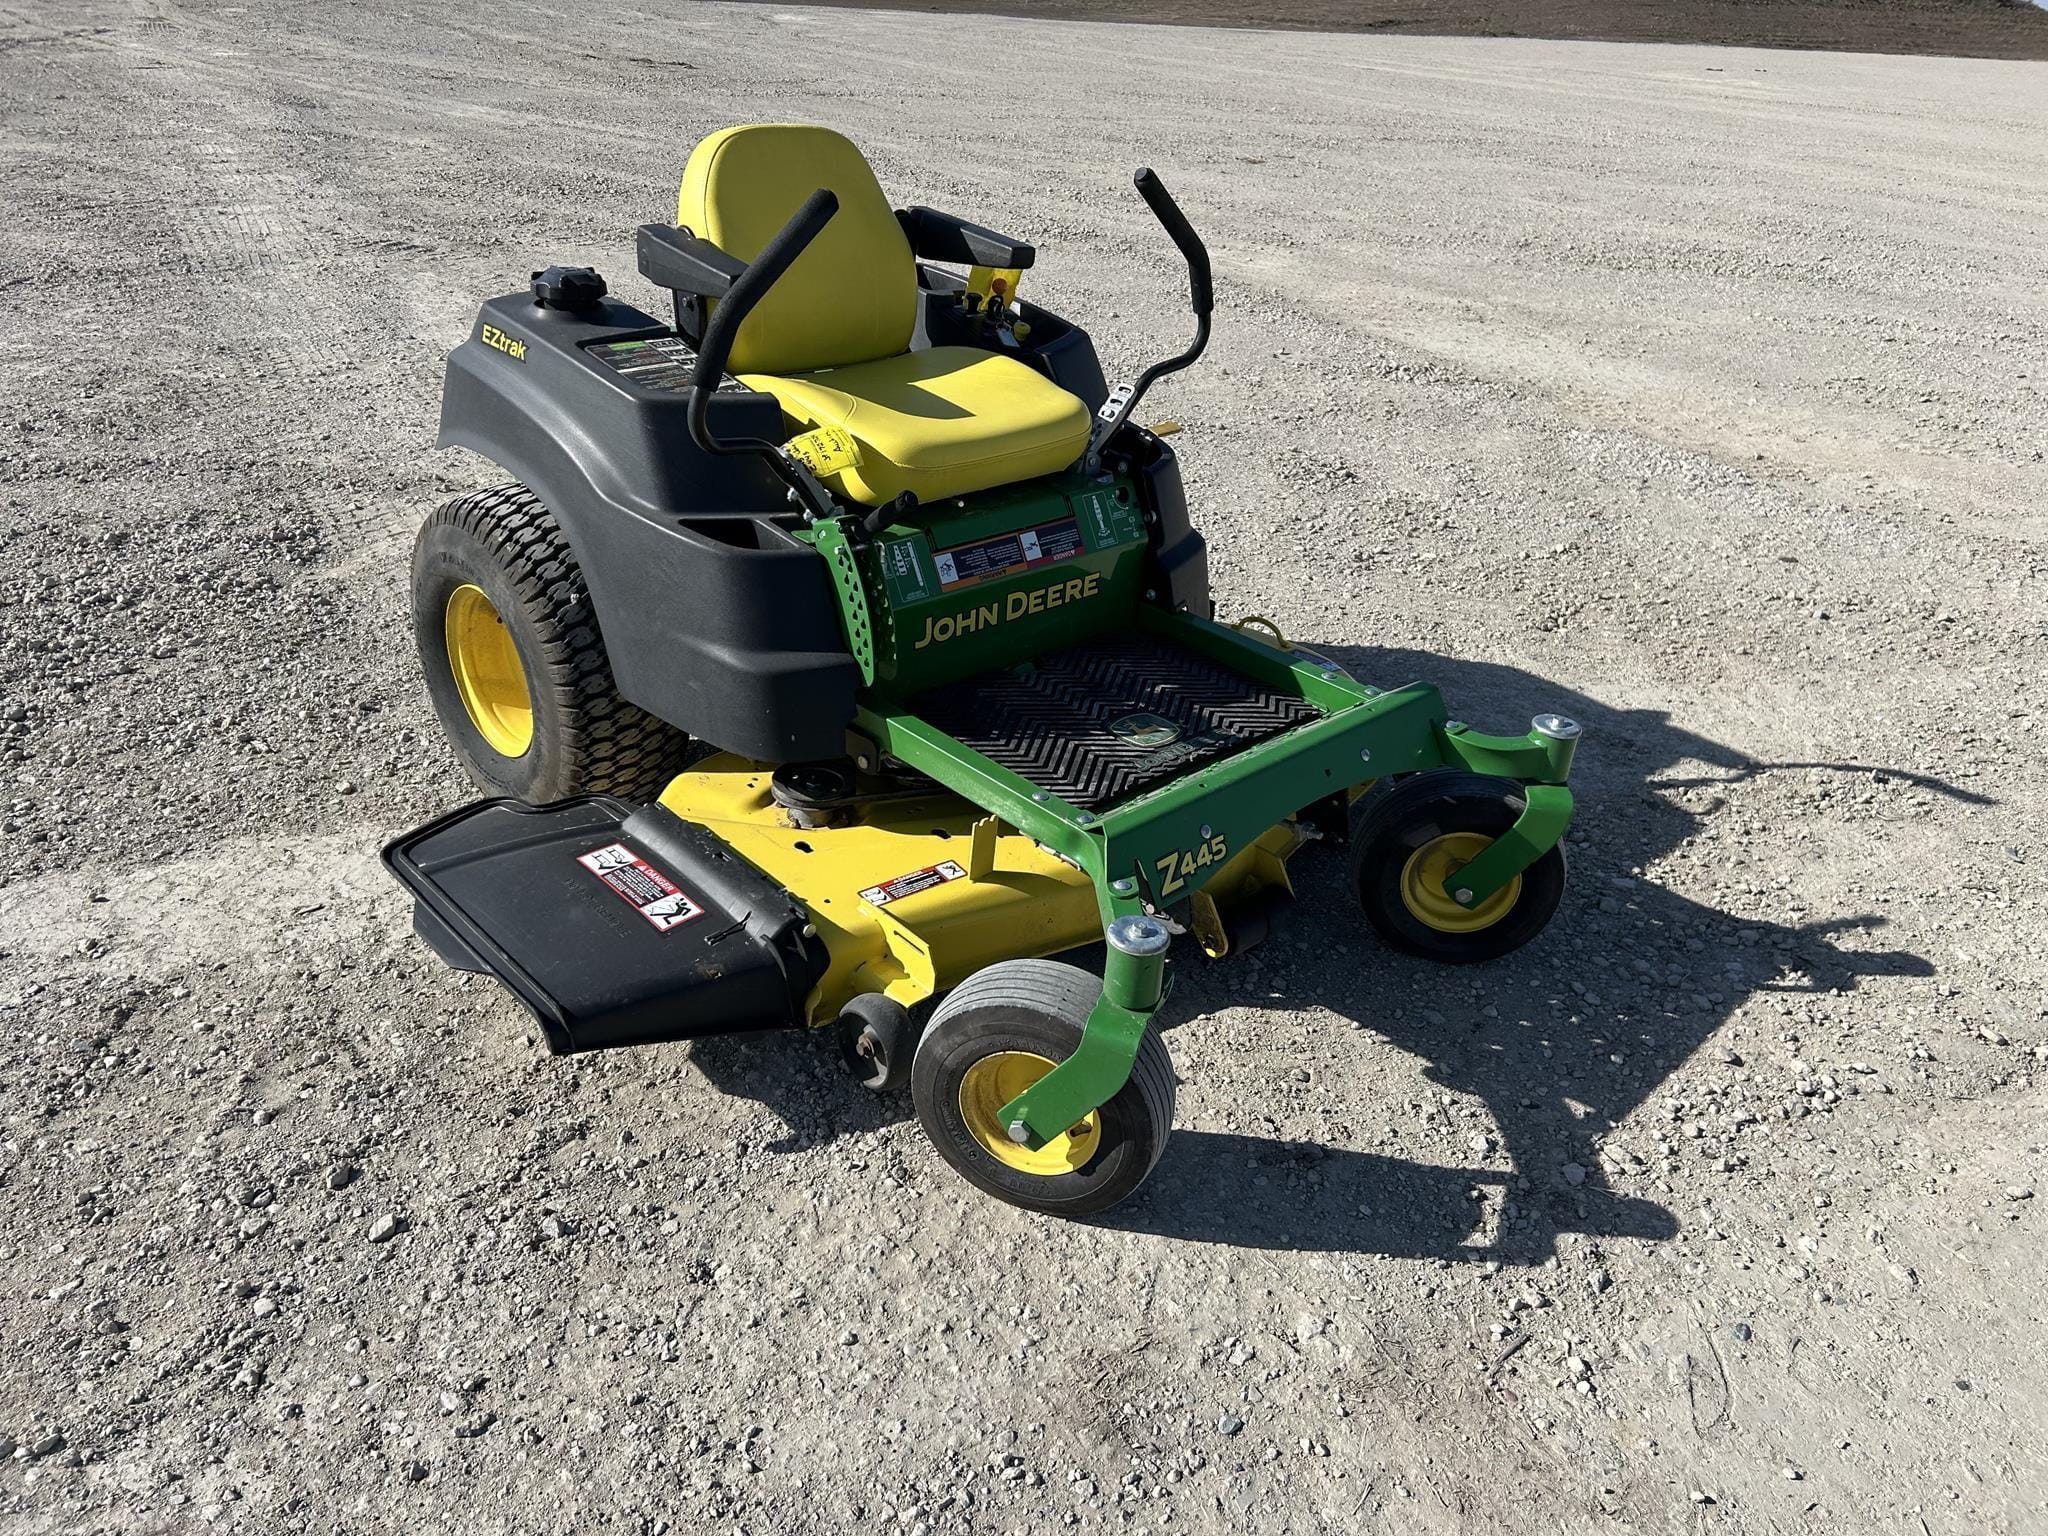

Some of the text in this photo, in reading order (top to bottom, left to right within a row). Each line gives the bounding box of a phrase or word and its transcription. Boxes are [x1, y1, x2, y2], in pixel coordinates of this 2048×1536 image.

[481, 322, 527, 362] EZtrak
[914, 571, 1101, 650] JOHN DEERE
[644, 868, 675, 892] DANGER
[1156, 834, 1227, 897] Z445
